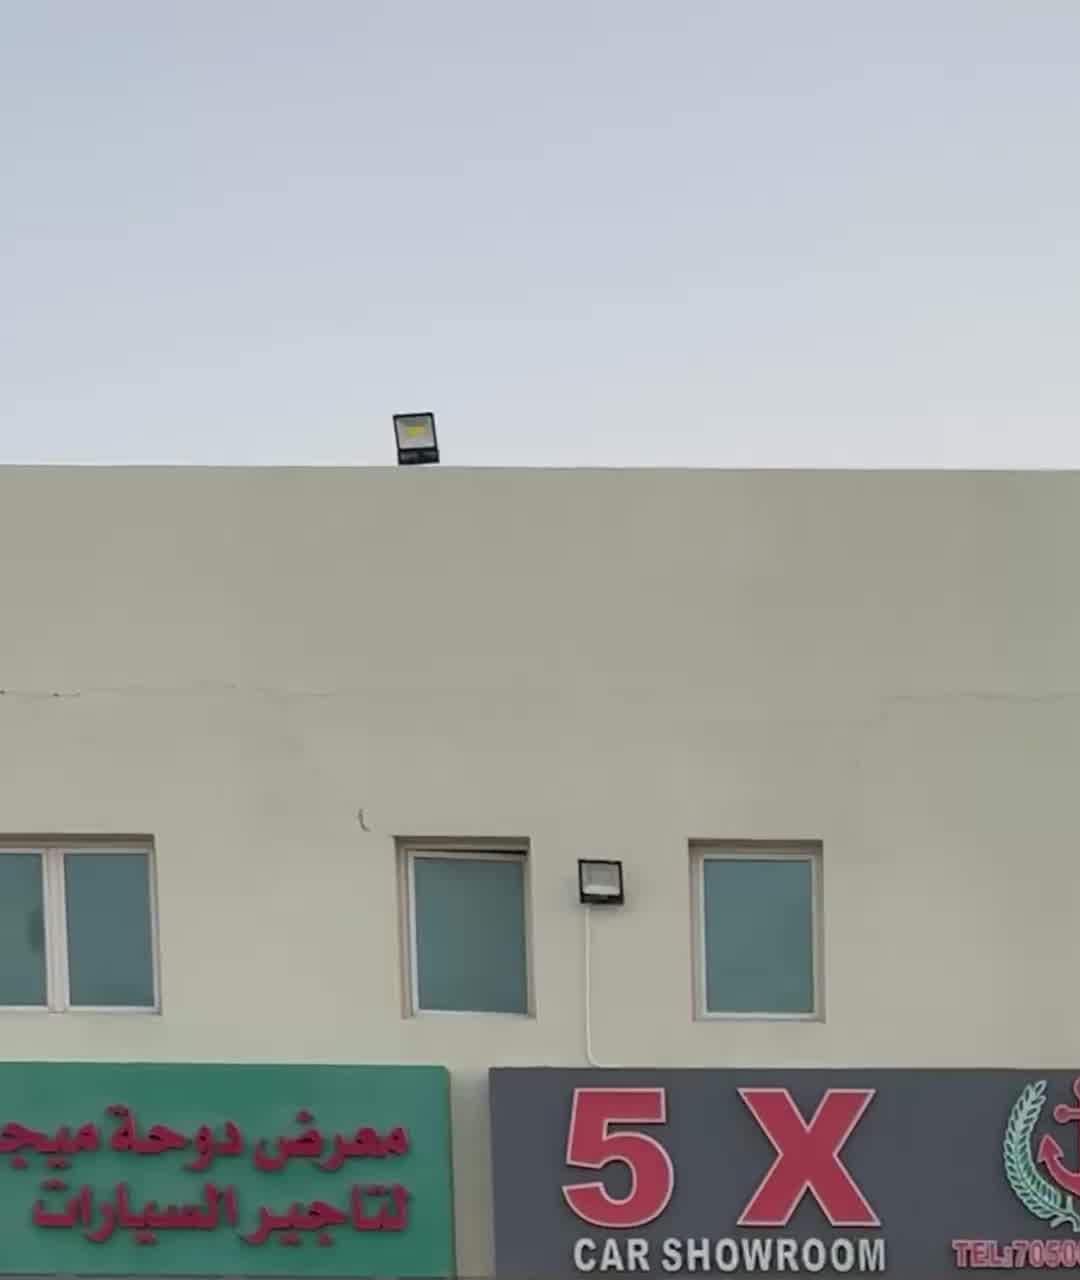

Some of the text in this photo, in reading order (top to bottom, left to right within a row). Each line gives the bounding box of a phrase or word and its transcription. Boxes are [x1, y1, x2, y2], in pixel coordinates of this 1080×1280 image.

[106, 1104, 244, 1172] دوحة
[252, 1106, 411, 1173] معرض
[562, 1086, 882, 1229] 5 X
[31, 1179, 239, 1246] السيارات
[573, 1236, 887, 1273] CAR SHOWROOM
